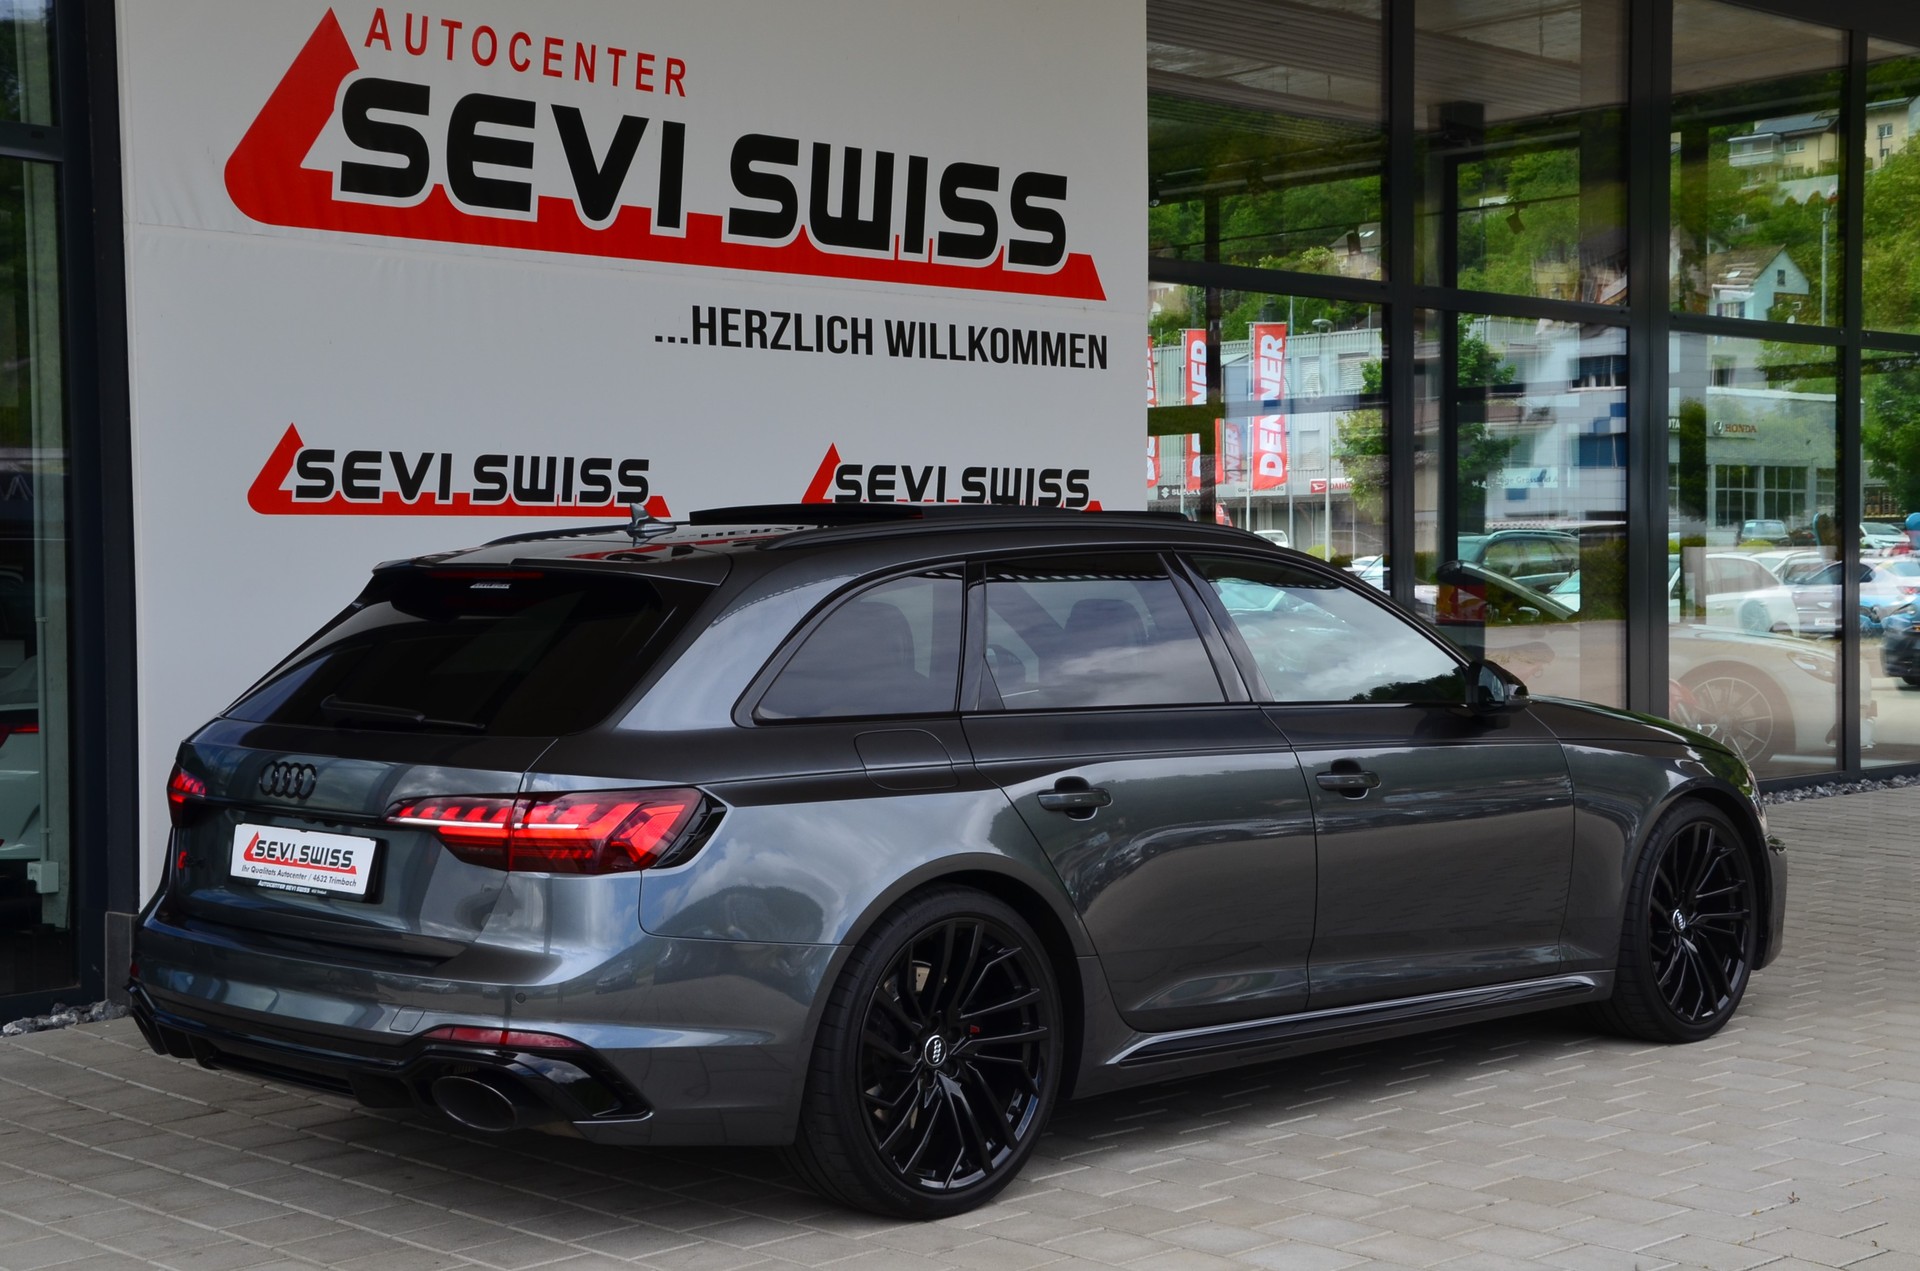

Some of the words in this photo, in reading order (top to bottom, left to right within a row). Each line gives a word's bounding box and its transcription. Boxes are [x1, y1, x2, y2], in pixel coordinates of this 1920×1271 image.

[364, 7, 687, 97] AUTOCENTER
[340, 77, 686, 229] SEVI
[727, 133, 1068, 267] SWISS
[654, 305, 873, 356] ...HERZLICH
[884, 319, 1107, 370] WILLKOMMEN
[1259, 334, 1283, 478] DENNER
[1725, 423, 1757, 433] HONDA
[295, 448, 453, 501] SEVI
[472, 454, 650, 505] SWISS
[834, 464, 947, 503] SEVI
[960, 466, 1090, 508] SWISS
[254, 839, 296, 861] SEVI
[298, 845, 354, 868] SWISS
[277, 869, 308, 881] Autocenter
[312, 874, 328, 883] 4632
[328, 876, 357, 887] Trimbach
